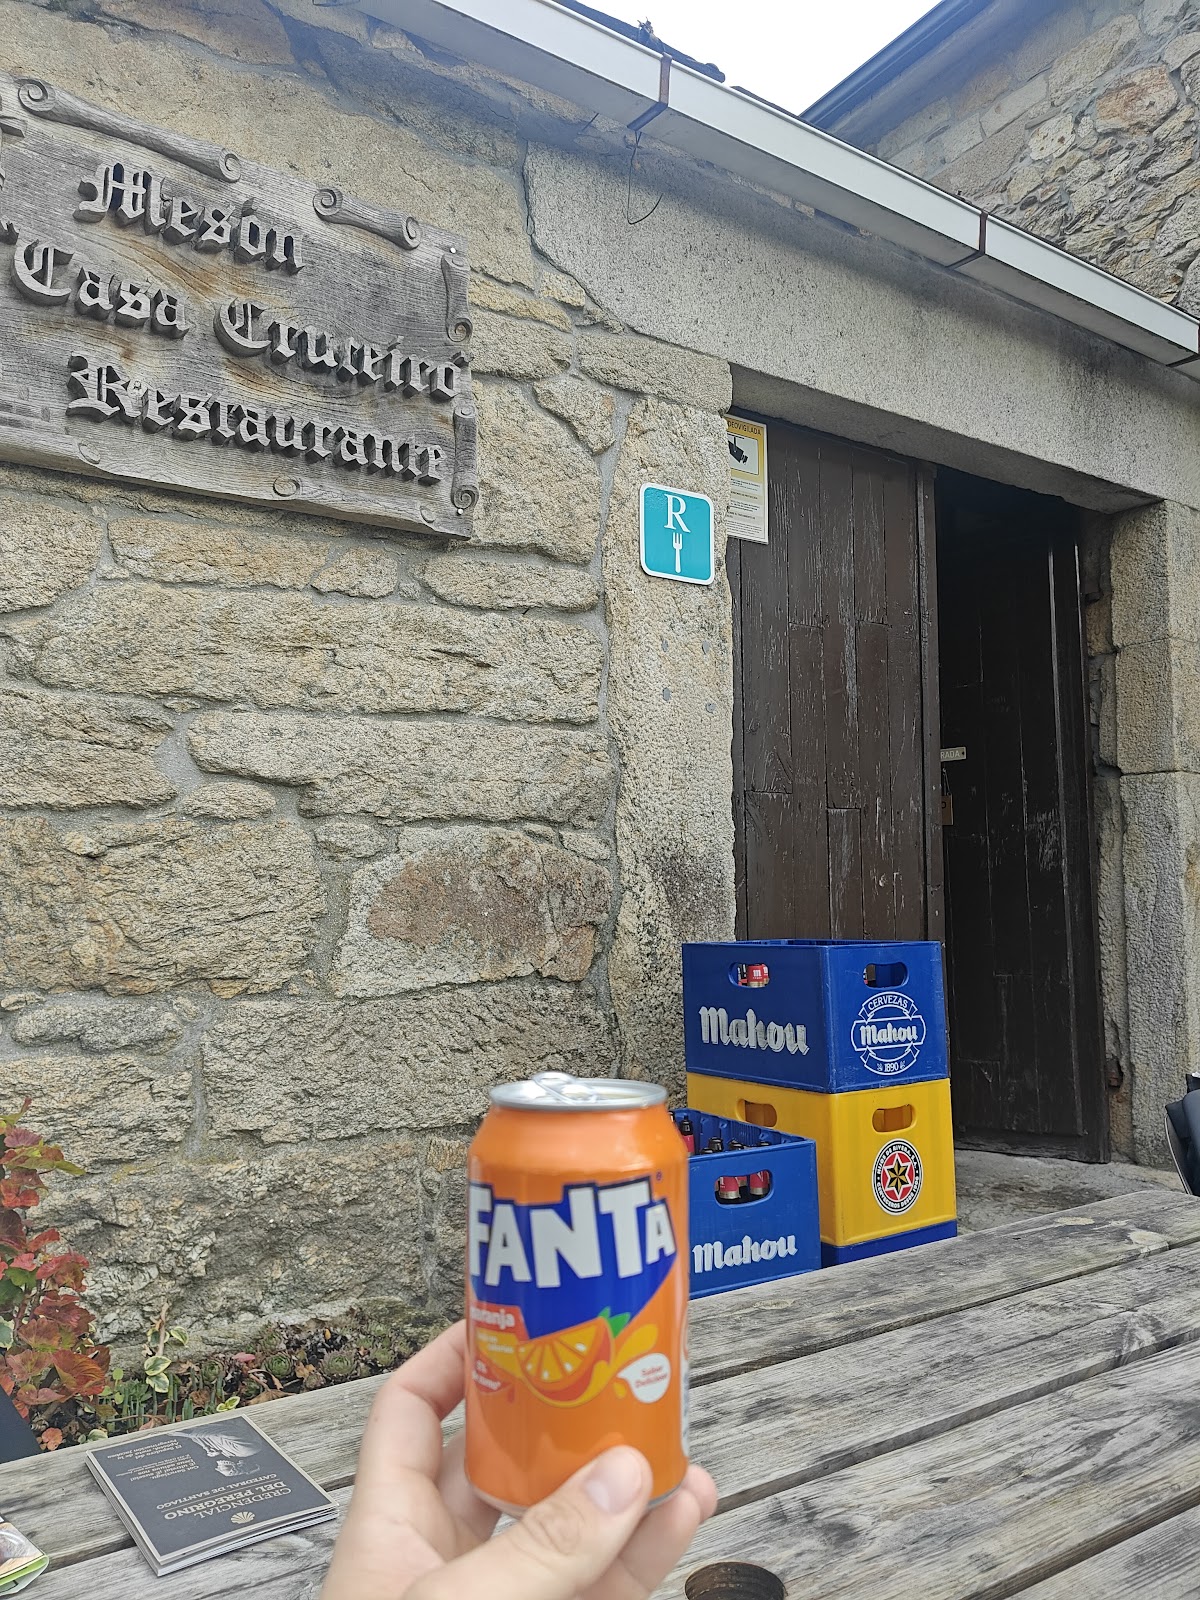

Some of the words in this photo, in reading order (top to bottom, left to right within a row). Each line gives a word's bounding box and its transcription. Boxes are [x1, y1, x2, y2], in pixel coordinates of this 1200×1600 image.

[73, 163, 304, 275] Mesón
[11, 240, 190, 339] Casa
[213, 298, 461, 403] Cruceiro
[66, 355, 443, 485] Restaurante
[727, 420, 762, 436] DEOVIGILADA
[664, 494, 691, 533] R
[940, 750, 961, 760] RADA
[868, 995, 908, 1011] CERVEZAS
[699, 1006, 810, 1056] Mahou
[860, 1022, 918, 1046] Mahou
[884, 1061, 899, 1073] 1890
[469, 1180, 677, 1289] FANTA
[692, 1235, 798, 1273] Mahou
[226, 1473, 277, 1489] CATEDRAL
[254, 1480, 286, 1493] DEL
[156, 1491, 211, 1509] SANTIAGO
[162, 1489, 255, 1520] PEREGRINO
[194, 1486, 292, 1520] CREDENCIAL
